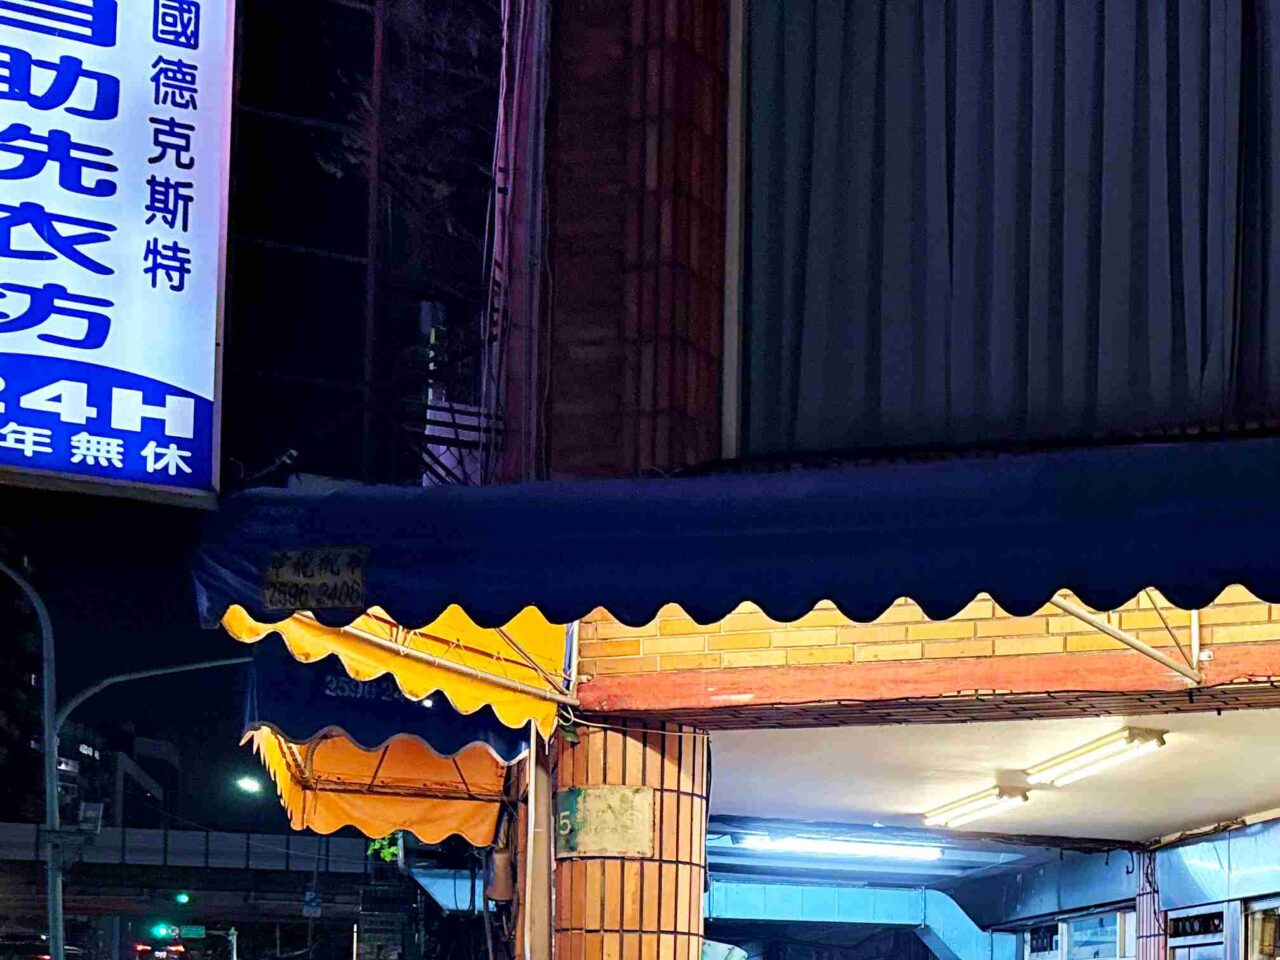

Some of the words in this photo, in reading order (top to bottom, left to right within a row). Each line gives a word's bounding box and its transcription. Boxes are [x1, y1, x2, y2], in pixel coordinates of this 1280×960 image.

[143, 0, 200, 292] 國德克斯特
[0, 378, 195, 440] 4H
